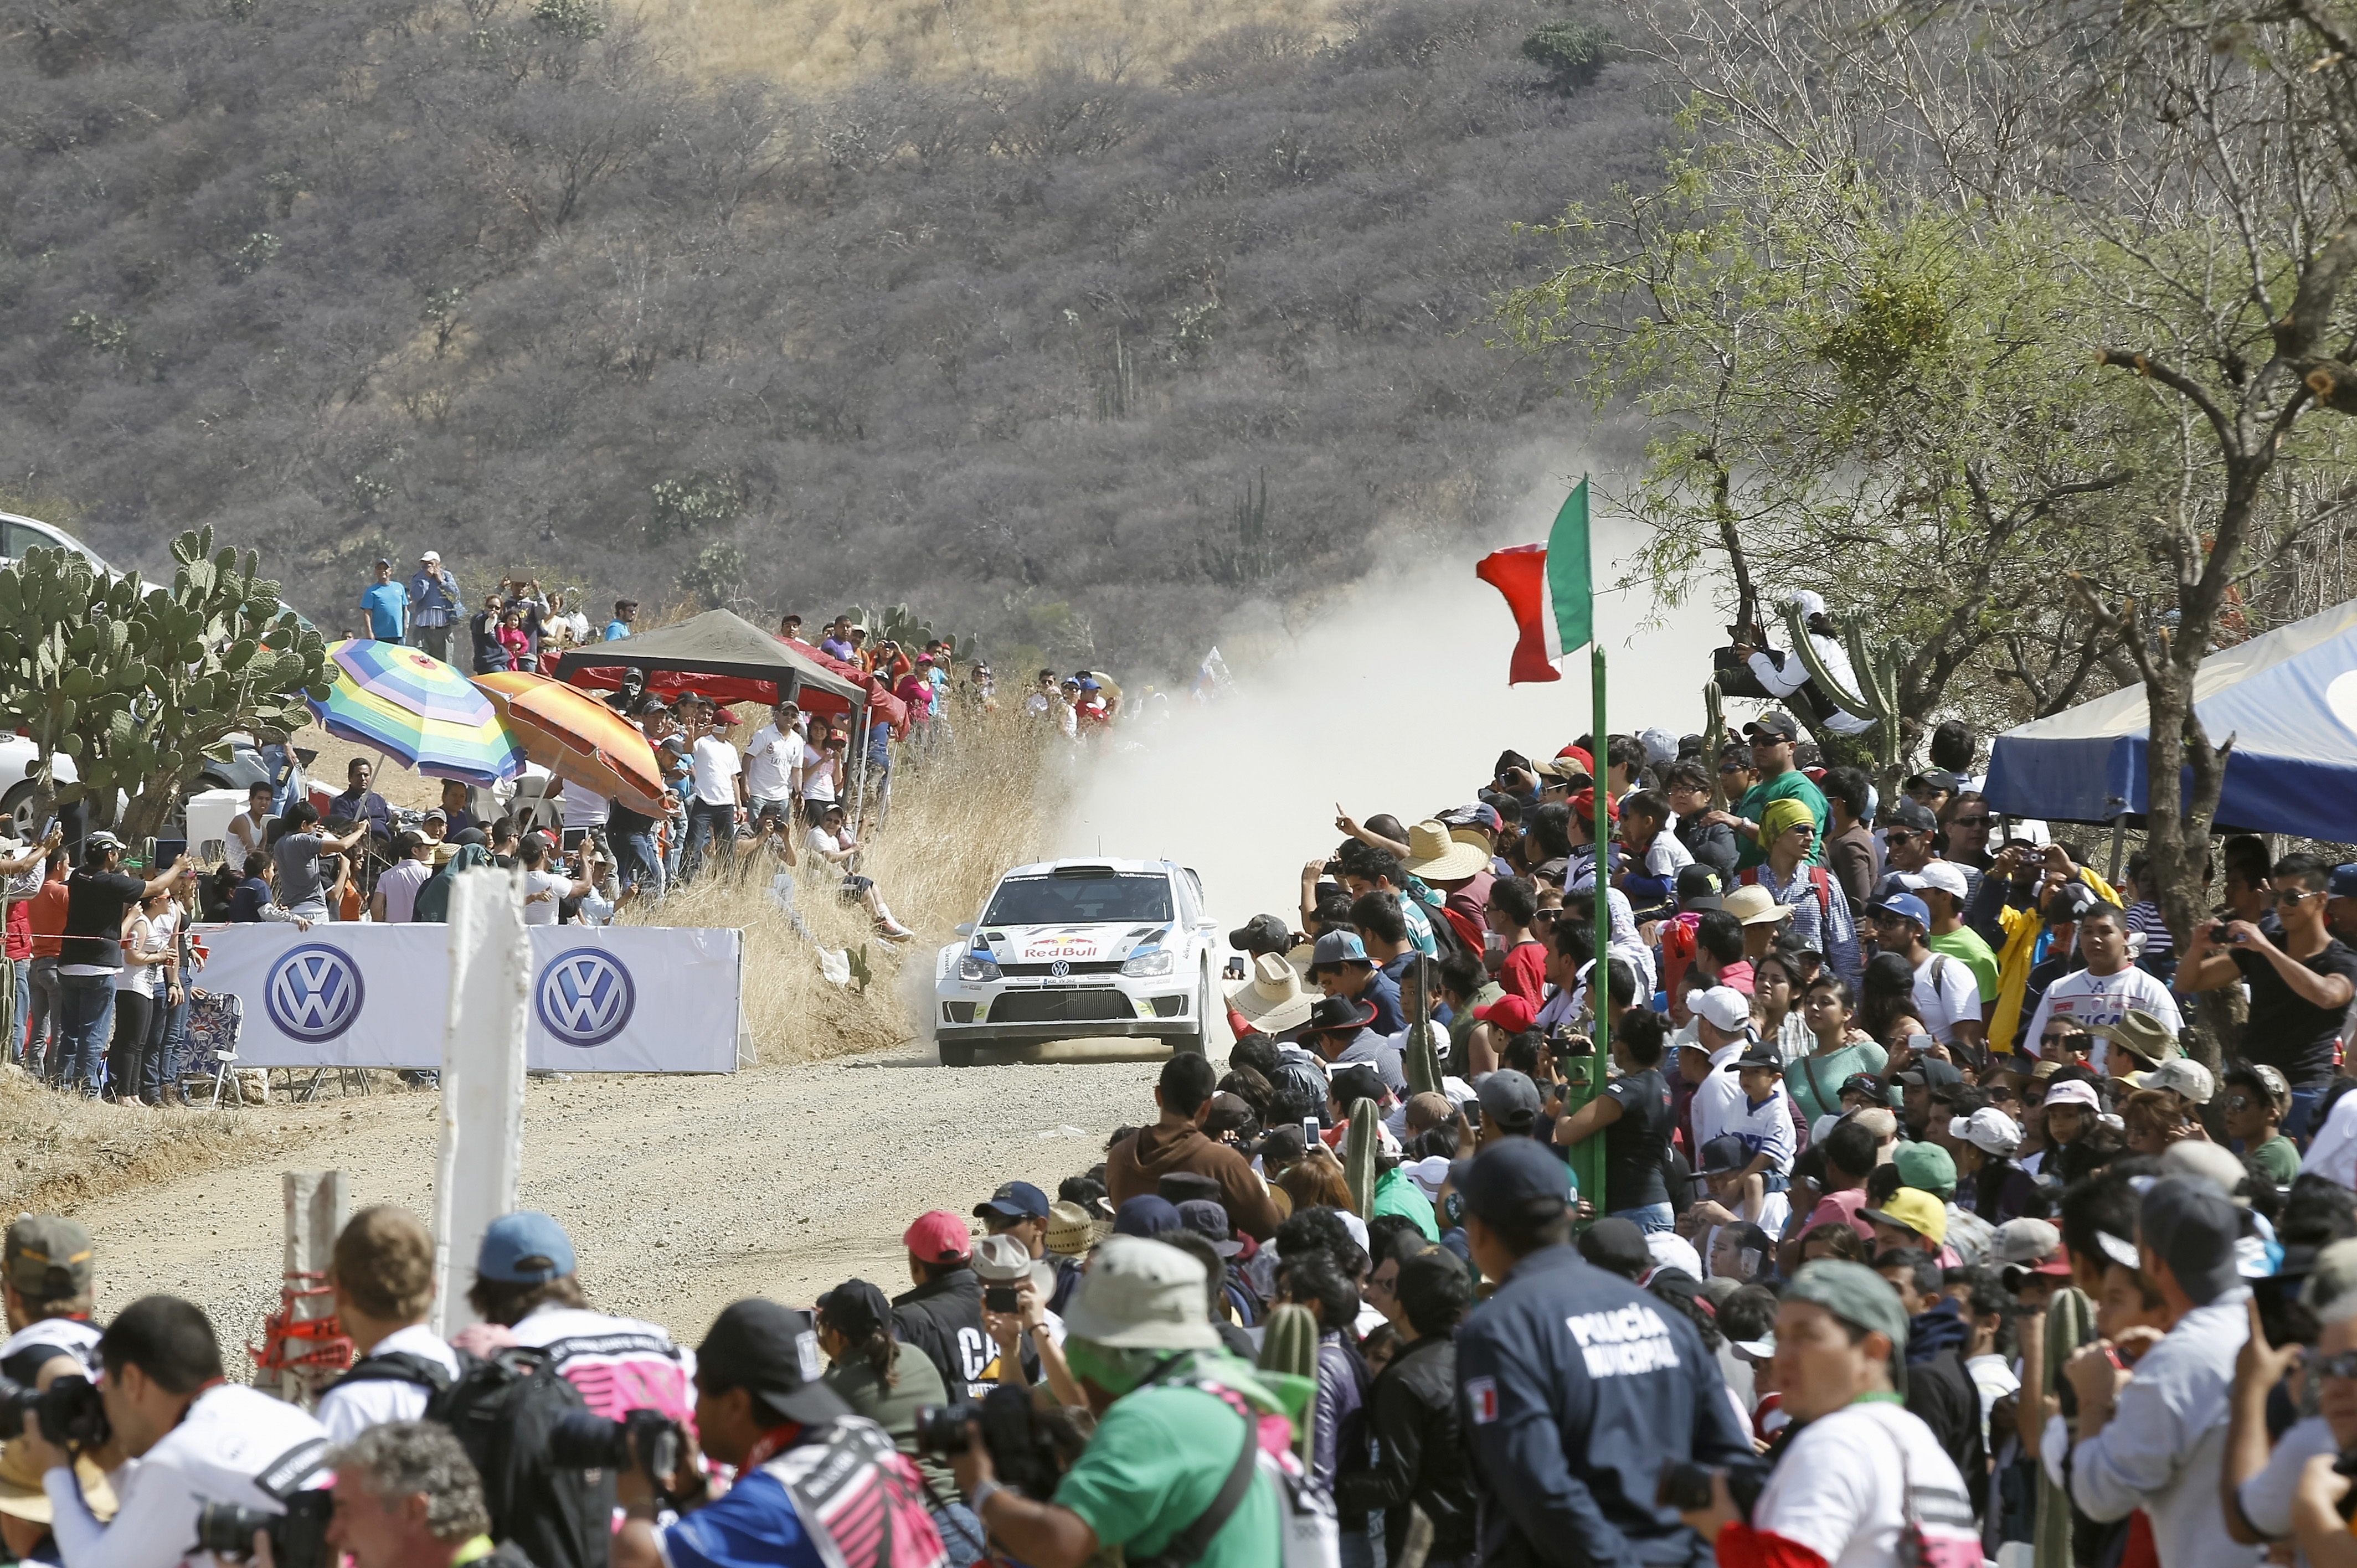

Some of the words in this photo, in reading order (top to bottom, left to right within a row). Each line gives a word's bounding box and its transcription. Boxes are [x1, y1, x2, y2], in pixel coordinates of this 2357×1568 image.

[1578, 843, 1597, 854] PEUGEO
[1025, 947, 1060, 957] Red
[1062, 947, 1097, 956] Bull
[956, 1327, 1001, 1381] CA
